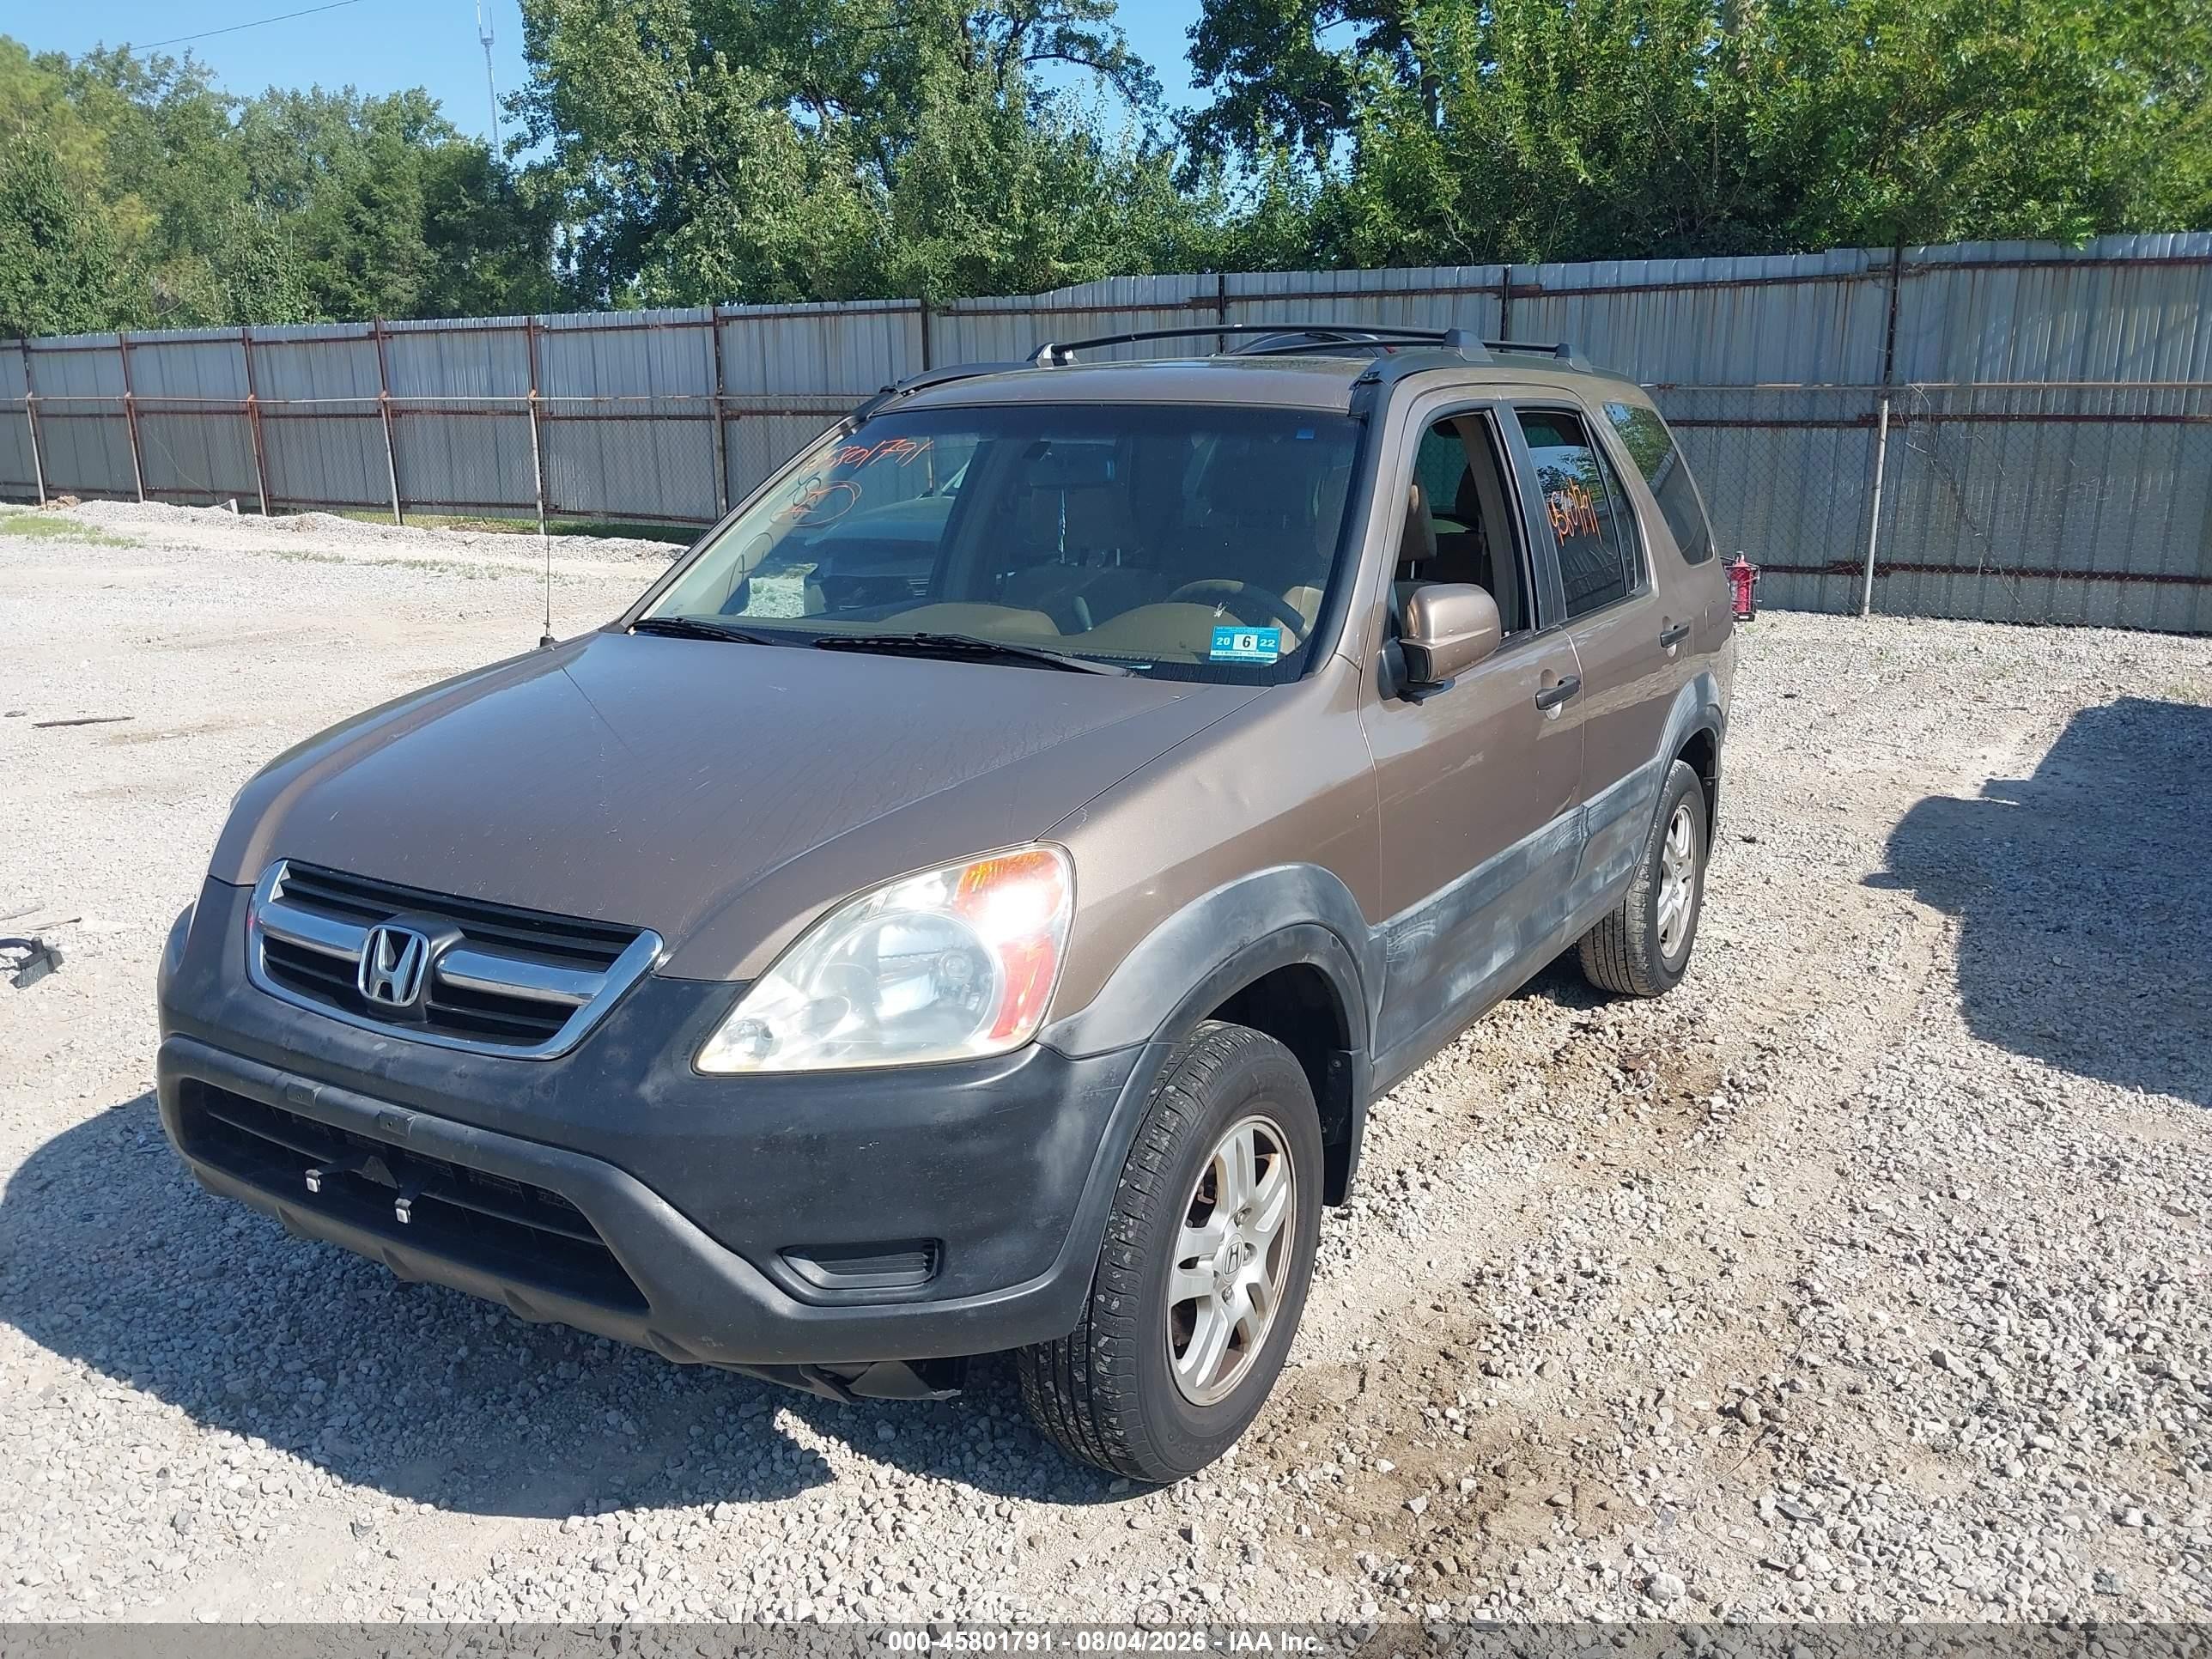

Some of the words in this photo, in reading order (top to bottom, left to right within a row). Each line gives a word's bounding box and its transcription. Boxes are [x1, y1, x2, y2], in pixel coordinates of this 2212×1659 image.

[1216, 636, 1231, 646] 20
[1242, 635, 1251, 648] 6
[1259, 638, 1276, 647] 22
